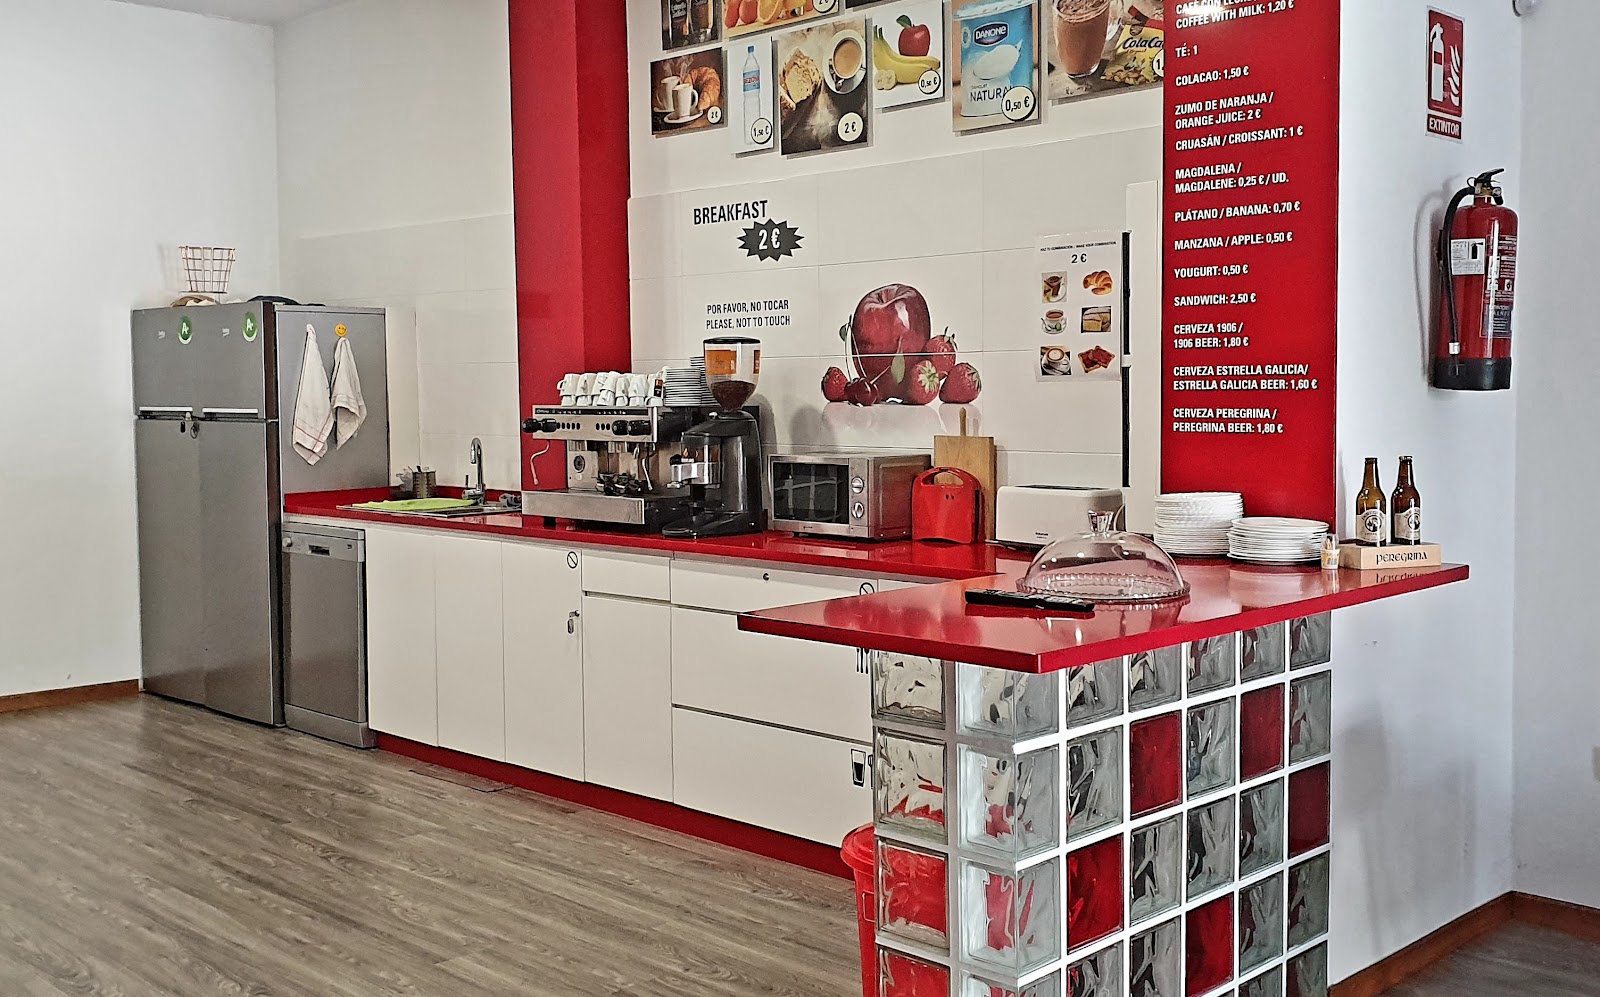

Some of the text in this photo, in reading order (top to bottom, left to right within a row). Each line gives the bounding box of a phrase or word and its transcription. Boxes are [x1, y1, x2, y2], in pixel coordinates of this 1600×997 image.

[1176, 14, 1210, 29] COFFEE
[1211, 8, 1236, 22] WITH
[1238, 4, 1266, 18] MILK:
[1268, 0, 1286, 13] 1,20
[1175, 43, 1198, 58] TÉ: 1
[1176, 66, 1249, 87] COLACAO: 1,50 €
[970, 85, 1012, 102] NATURA
[1006, 96, 1029, 112] 0,50 €
[1175, 92, 1274, 116] ZUMO DE NARANJA /
[844, 121, 856, 133] 2 €
[1175, 109, 1261, 130] ORANGE JUICE: 2 €
[1429, 117, 1459, 136] EXTINTOR
[1175, 126, 1303, 150] CRUASÁN / CROISSANT: 1 €
[1175, 162, 1242, 180] MAGDALENA /
[1175, 178, 1236, 193] MAGDALENE:
[1238, 175, 1256, 188] 0,25
[1258, 174, 1264, 184] €
[1272, 172, 1289, 184] UD.
[693, 200, 768, 225] BREAKFAST
[1175, 201, 1300, 222] PLÁTANO / BANANA: 0,70 €
[758, 228, 780, 250] 2 €
[1175, 232, 1293, 250] MANZANA / APPLE: 0,50 €
[1071, 254, 1087, 263] 2 €
[1174, 264, 1249, 278] YOUGURT: 0,50 €
[707, 300, 788, 314] POR FAVOR, NO TOCAR
[1174, 293, 1256, 306] SANDWICH: 2,50 €
[706, 315, 790, 330] PLEASE, NOT TO TOUCH
[1174, 322, 1243, 334] CERVEZA 1906 /
[1173, 337, 1249, 348] 1906 BEER: 1,80 €
[1173, 366, 1214, 376] CERVEZA
[1216, 365, 1262, 376] ESTRELLA
[1173, 379, 1318, 390] ESTRELLA GALICIA BEER: 1,60 €
[1173, 408, 1277, 420] CERVEZA PEREGRINA /
[1173, 422, 1283, 433] PEREGRINA BEER: 1,80 €
[1376, 551, 1427, 565] PEREGRINA
